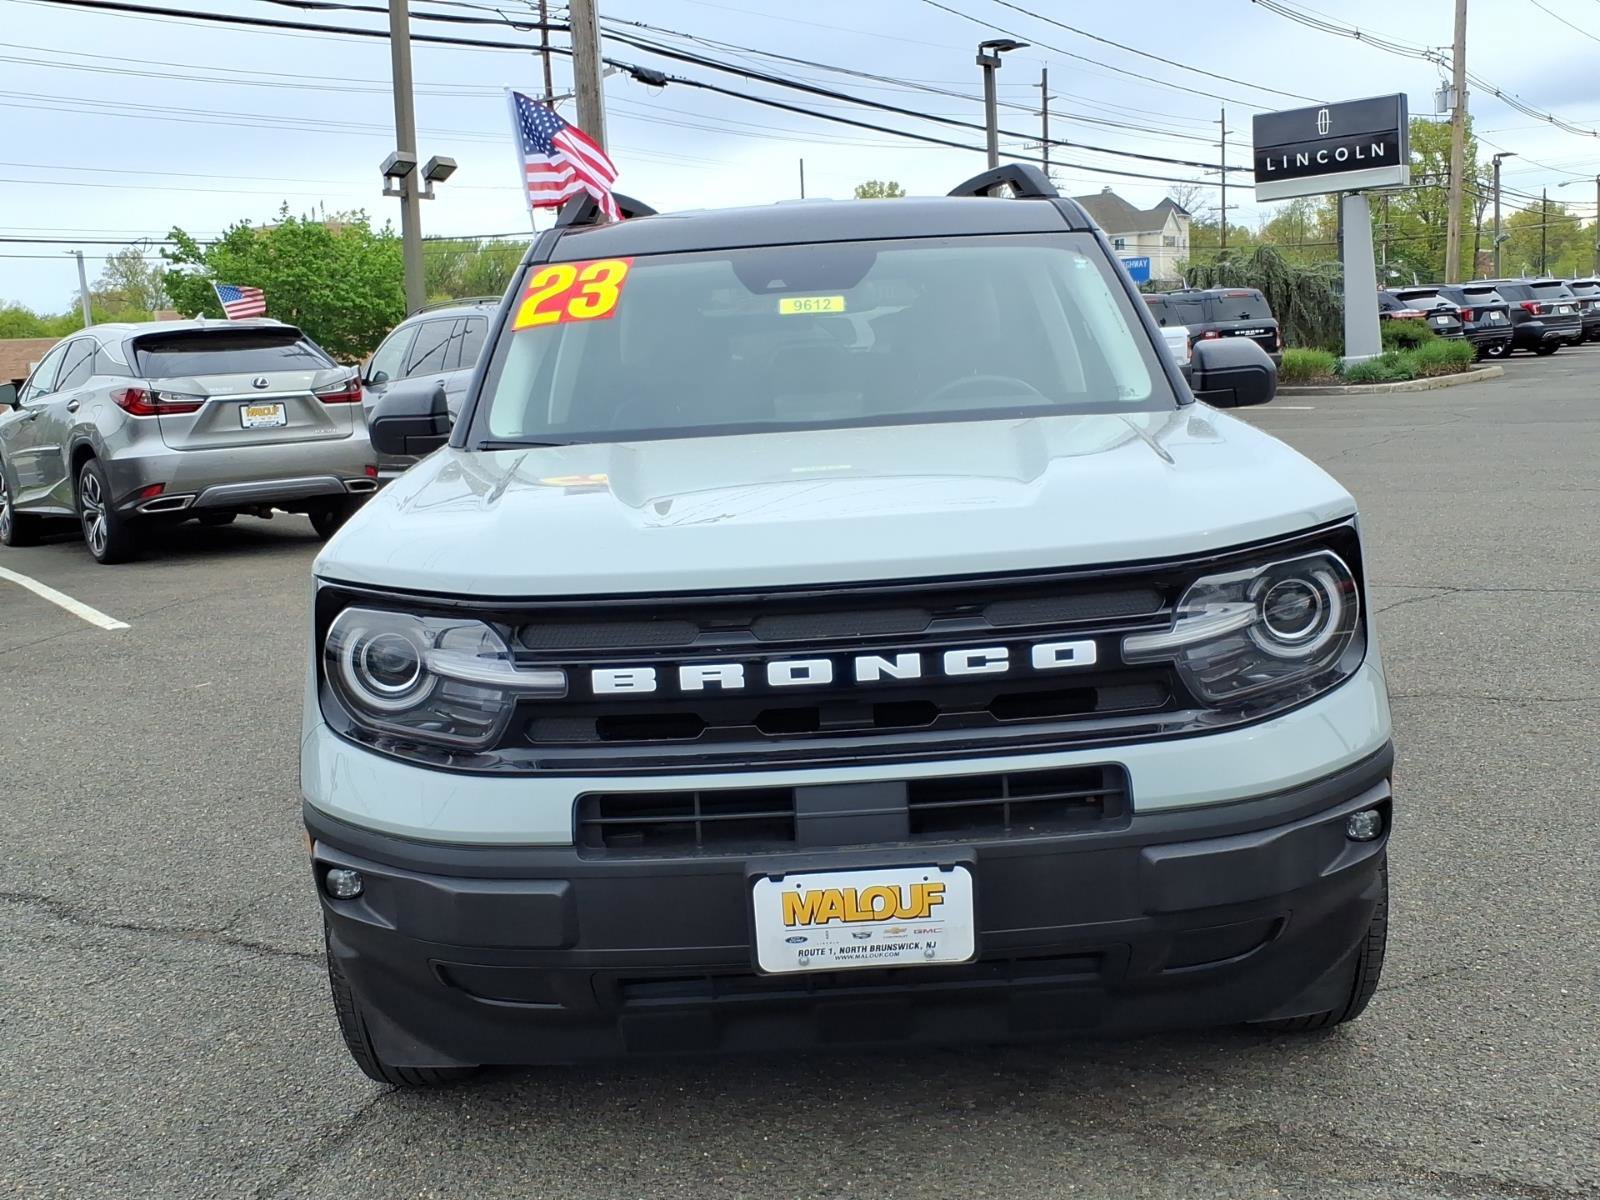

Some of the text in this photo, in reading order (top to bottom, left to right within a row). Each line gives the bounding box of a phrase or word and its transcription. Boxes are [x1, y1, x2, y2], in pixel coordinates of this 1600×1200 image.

[1266, 142, 1384, 171] LINCOLN
[513, 260, 629, 330] 23
[793, 298, 832, 311] 9612
[591, 639, 1098, 695] BRONCO
[781, 882, 946, 926] MALOUF
[798, 941, 937, 957] ROUTE 1, NORTH BRUNSWICK, NJ
[834, 951, 900, 961] WWW.MALOUF.COM
